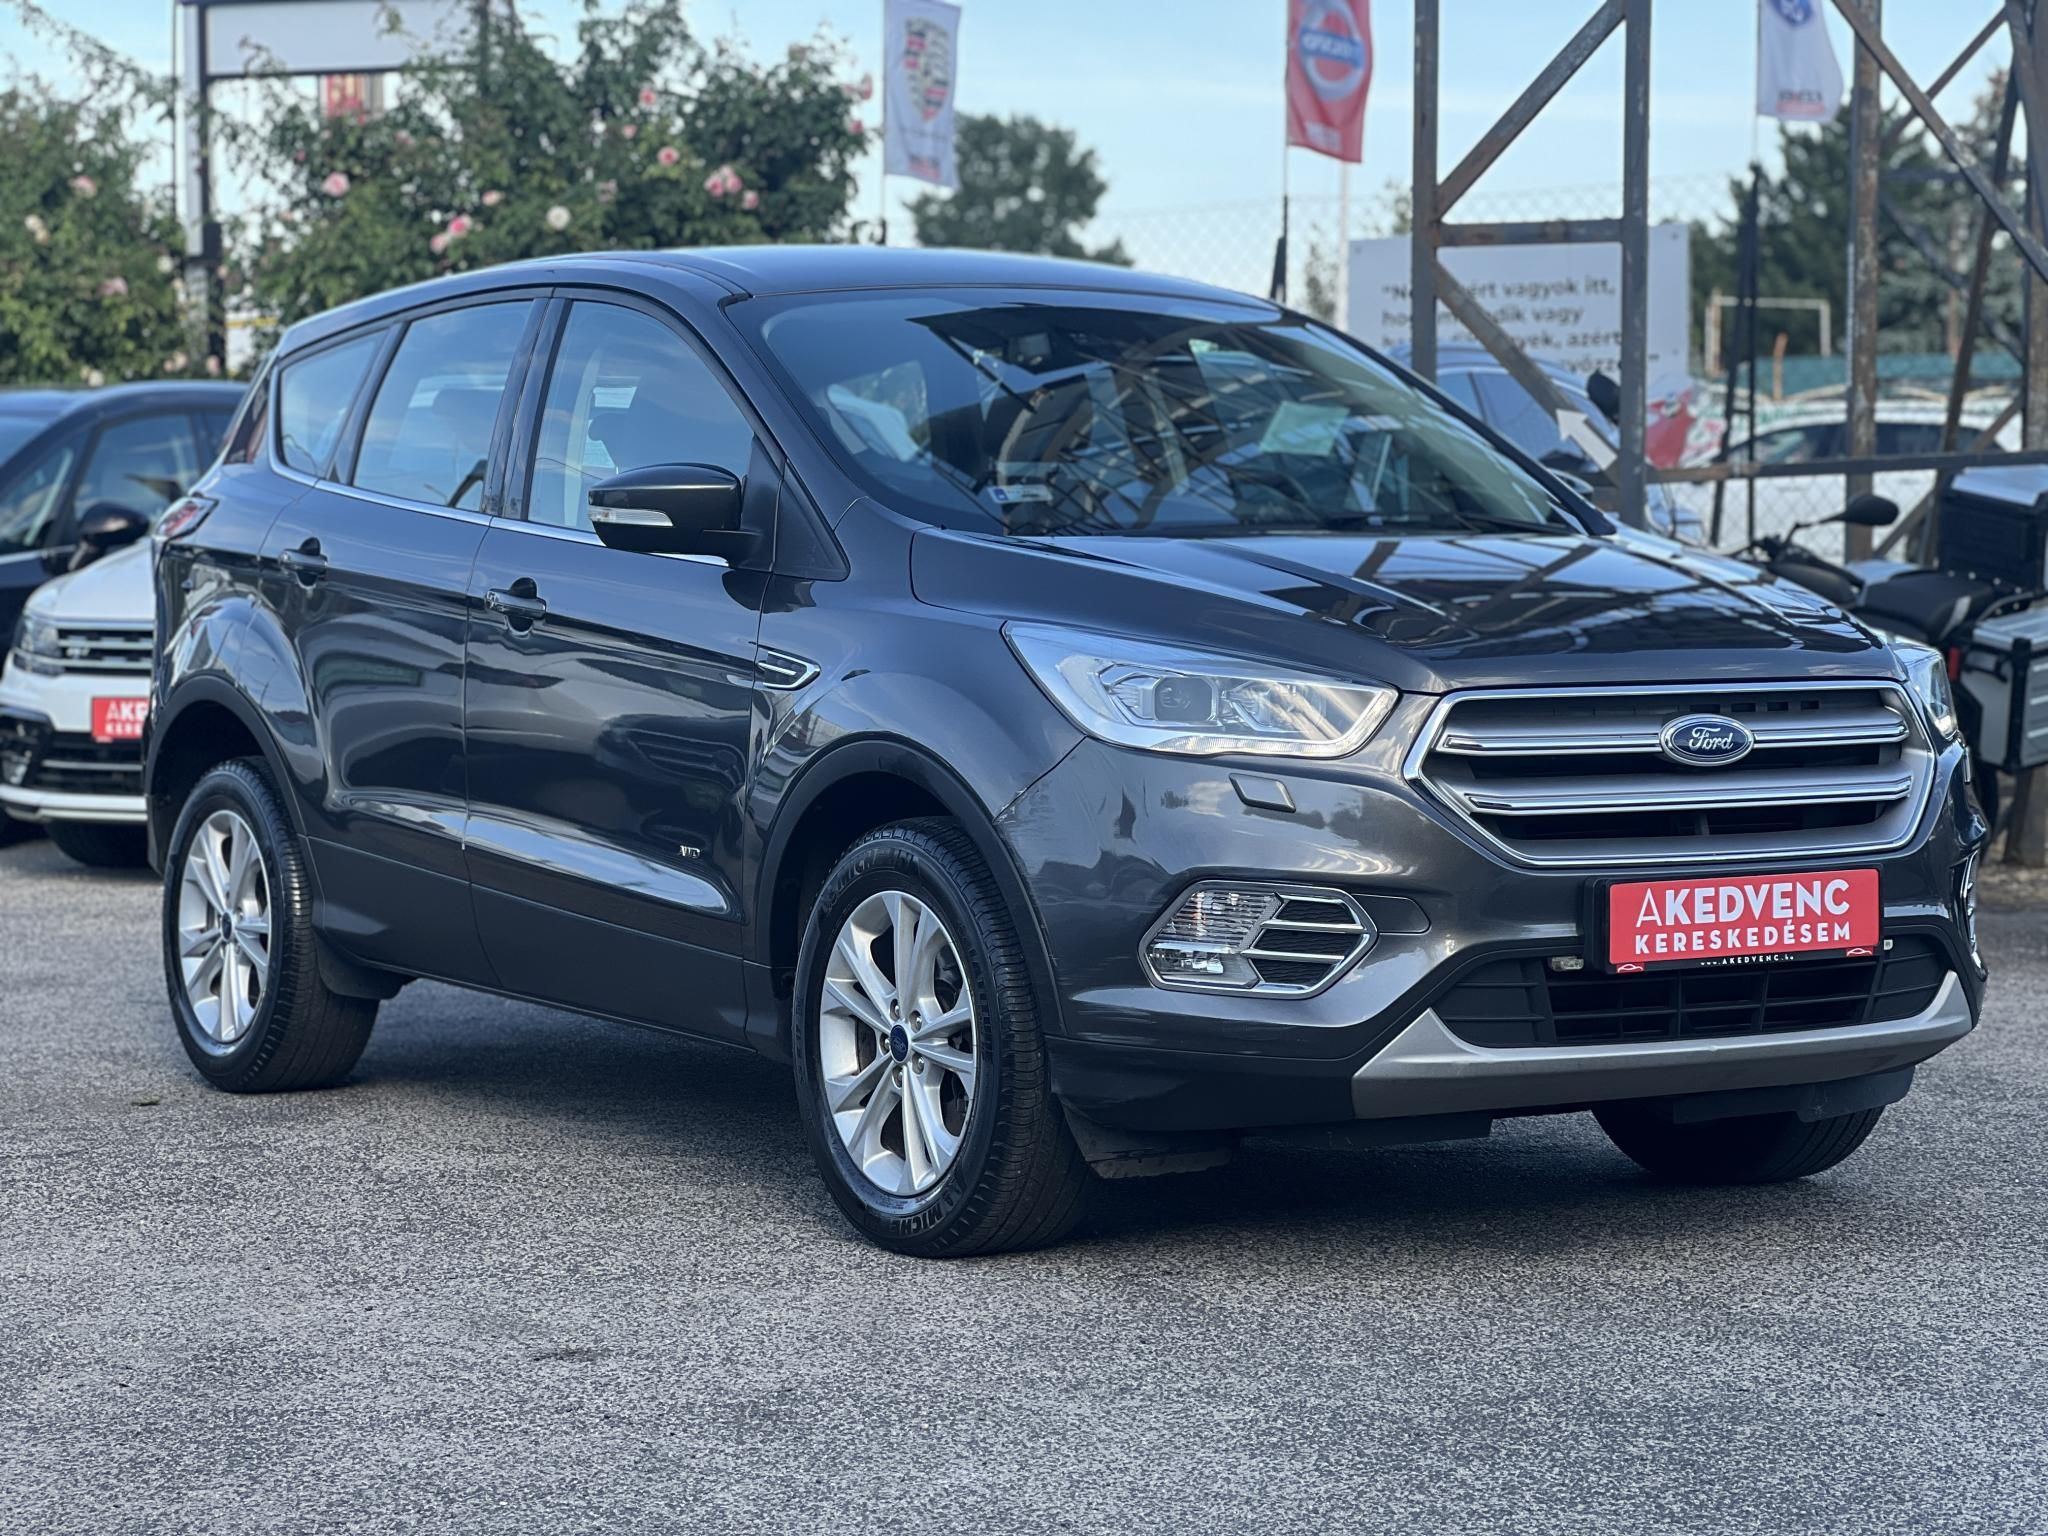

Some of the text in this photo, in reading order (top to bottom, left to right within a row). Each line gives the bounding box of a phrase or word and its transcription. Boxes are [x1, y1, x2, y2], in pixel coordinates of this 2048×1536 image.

[1502, 278, 1577, 301] vagyok
[1531, 305, 1583, 326] vagy
[1688, 726, 1733, 750] Ford
[1635, 878, 1850, 928] AKEDVENC
[1634, 918, 1851, 955] KERESKEDÉSEM
